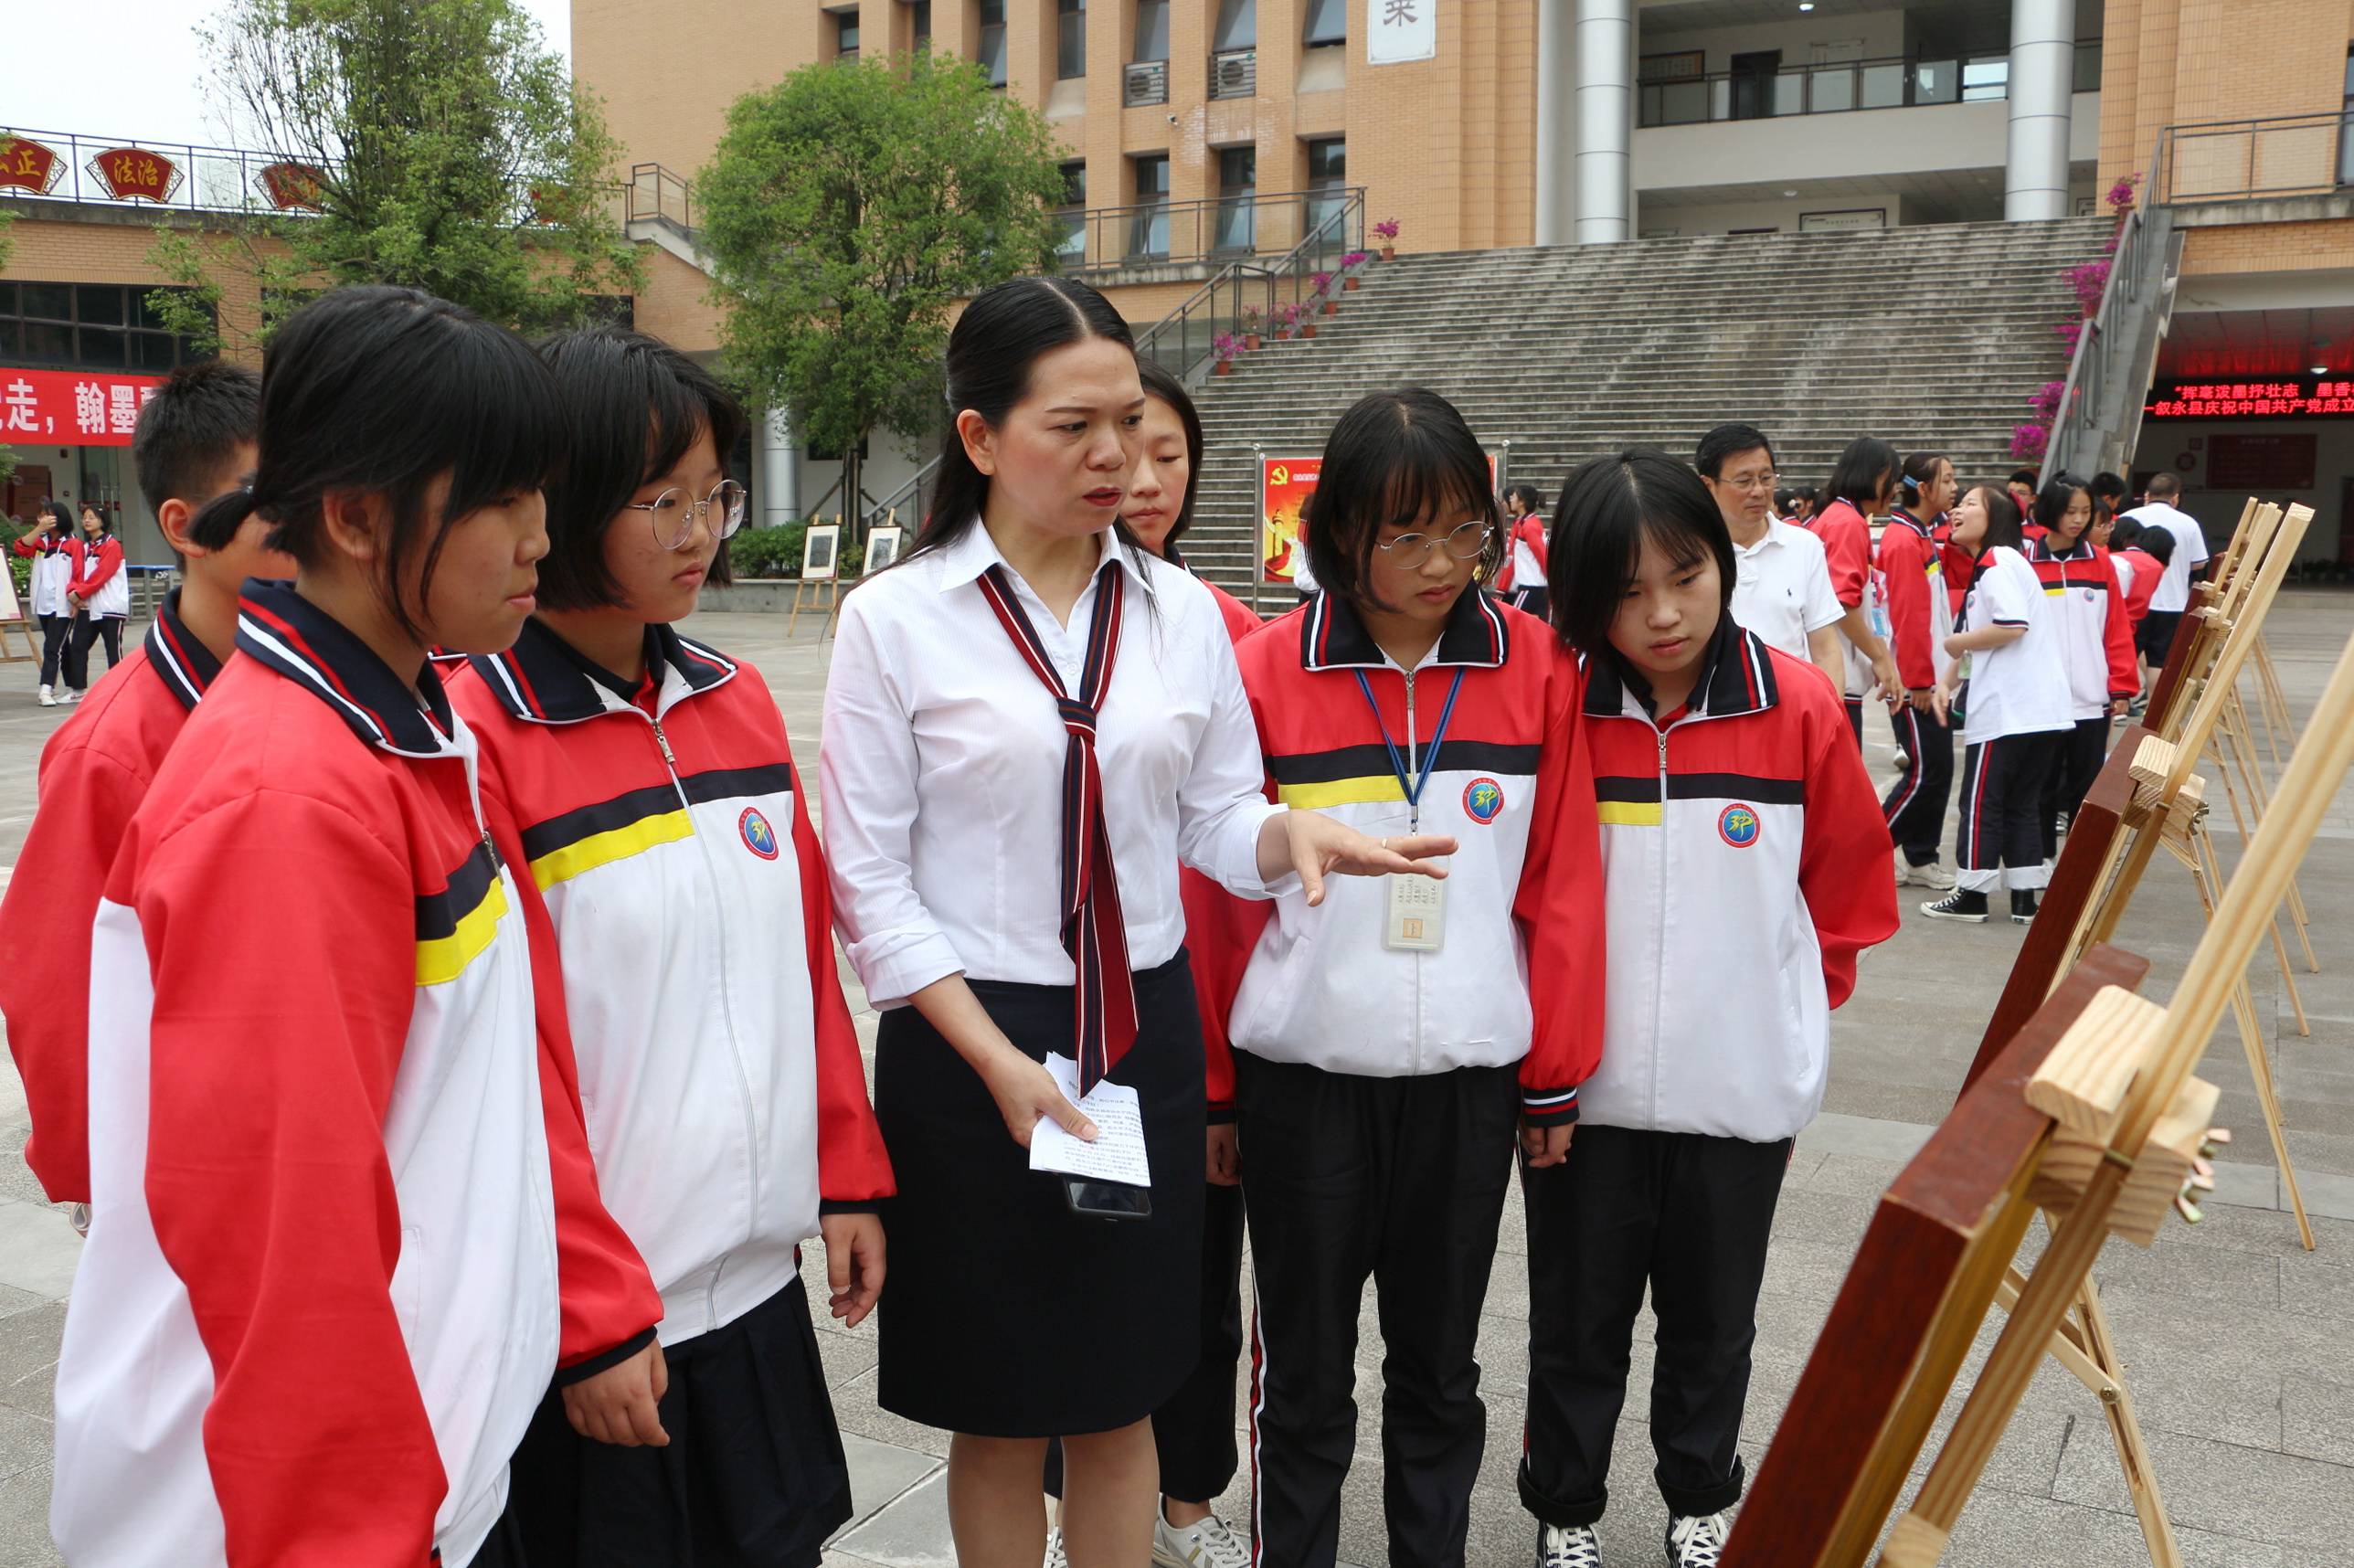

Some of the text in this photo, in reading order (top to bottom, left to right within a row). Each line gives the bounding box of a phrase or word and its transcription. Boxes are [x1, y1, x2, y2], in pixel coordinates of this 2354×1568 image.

[113, 155, 159, 186] 法治
[2317, 382, 2354, 397] 墨香
[0, 377, 157, 435] 走，翰墨
